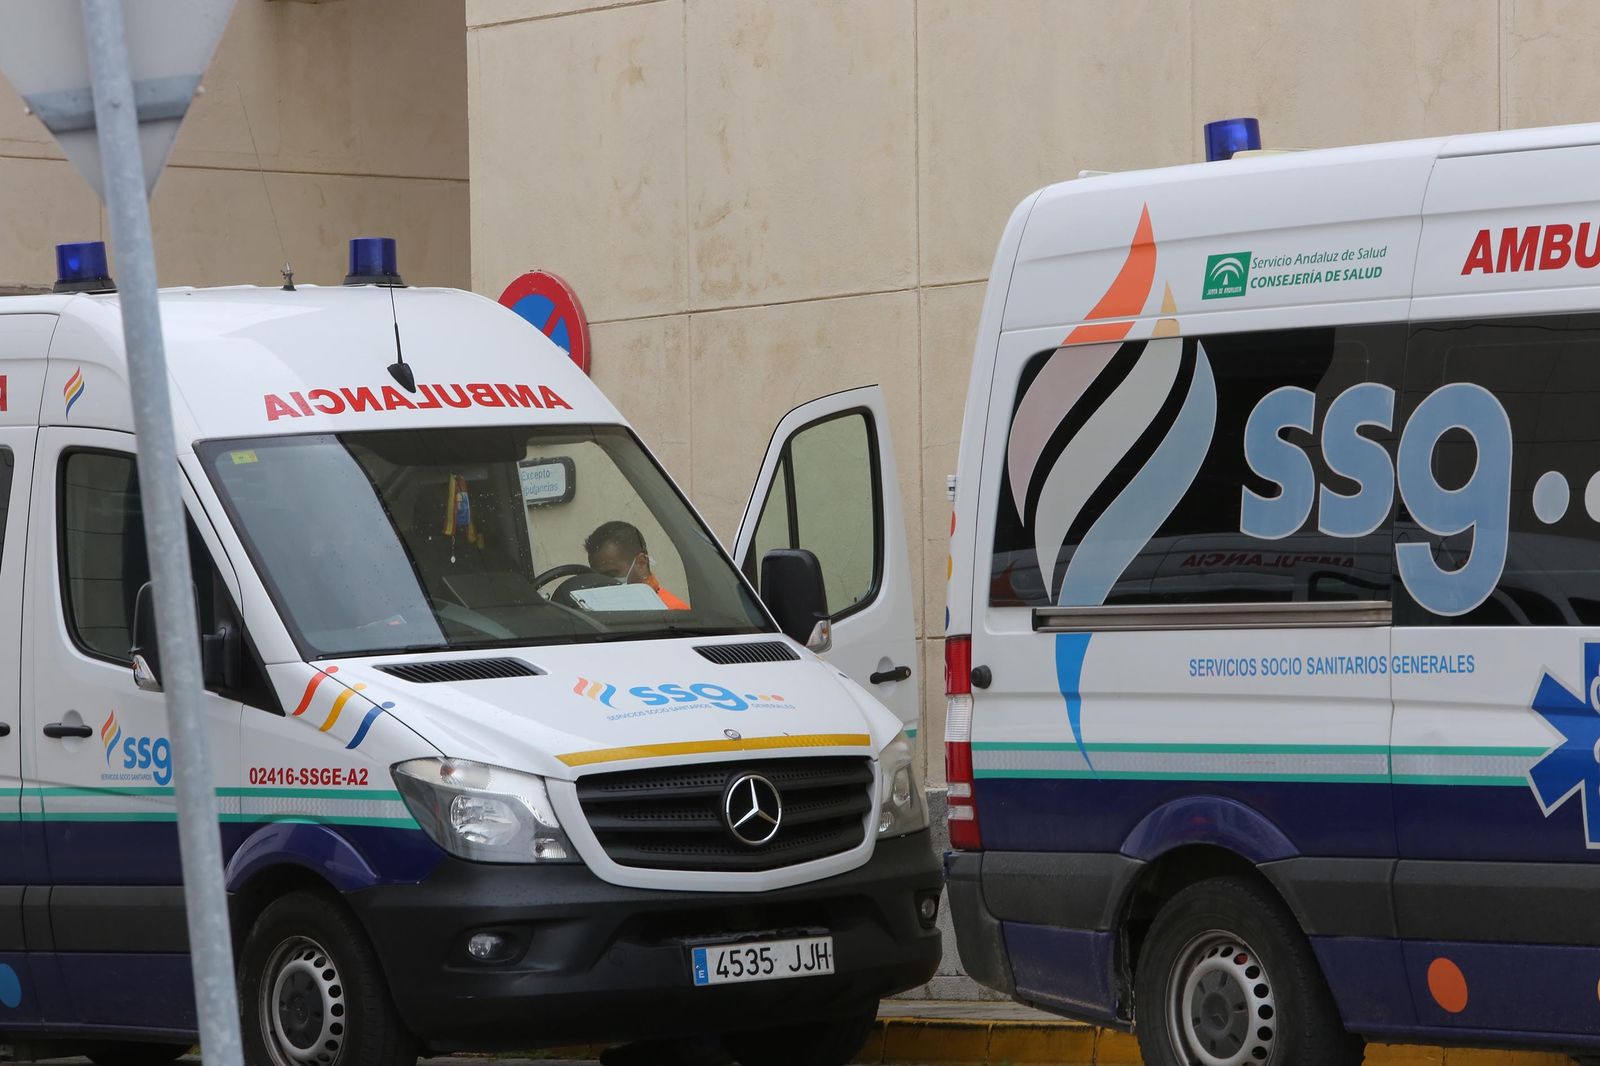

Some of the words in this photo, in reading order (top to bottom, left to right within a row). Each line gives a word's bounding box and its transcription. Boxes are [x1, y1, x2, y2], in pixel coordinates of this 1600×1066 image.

[1252, 255, 1292, 269] Servicio
[1294, 252, 1338, 265] Andaluz
[1341, 249, 1355, 261] de
[1357, 246, 1387, 260] Salud
[1250, 269, 1322, 288] CONSEJERÍA
[1325, 270, 1341, 283] DE
[1343, 266, 1382, 282] SALUD
[521, 469, 550, 481] Excepto
[1189, 658, 1257, 677] SERVICIOS
[1260, 657, 1301, 676] SOCIO
[1306, 655, 1387, 675] SANITARIOS
[1391, 654, 1475, 674] GENERALES
[249, 767, 368, 785] 02416-SSGE-A2
[716, 947, 774, 978] 4535
[788, 942, 829, 972] JJH
[698, 970, 705, 979] E
